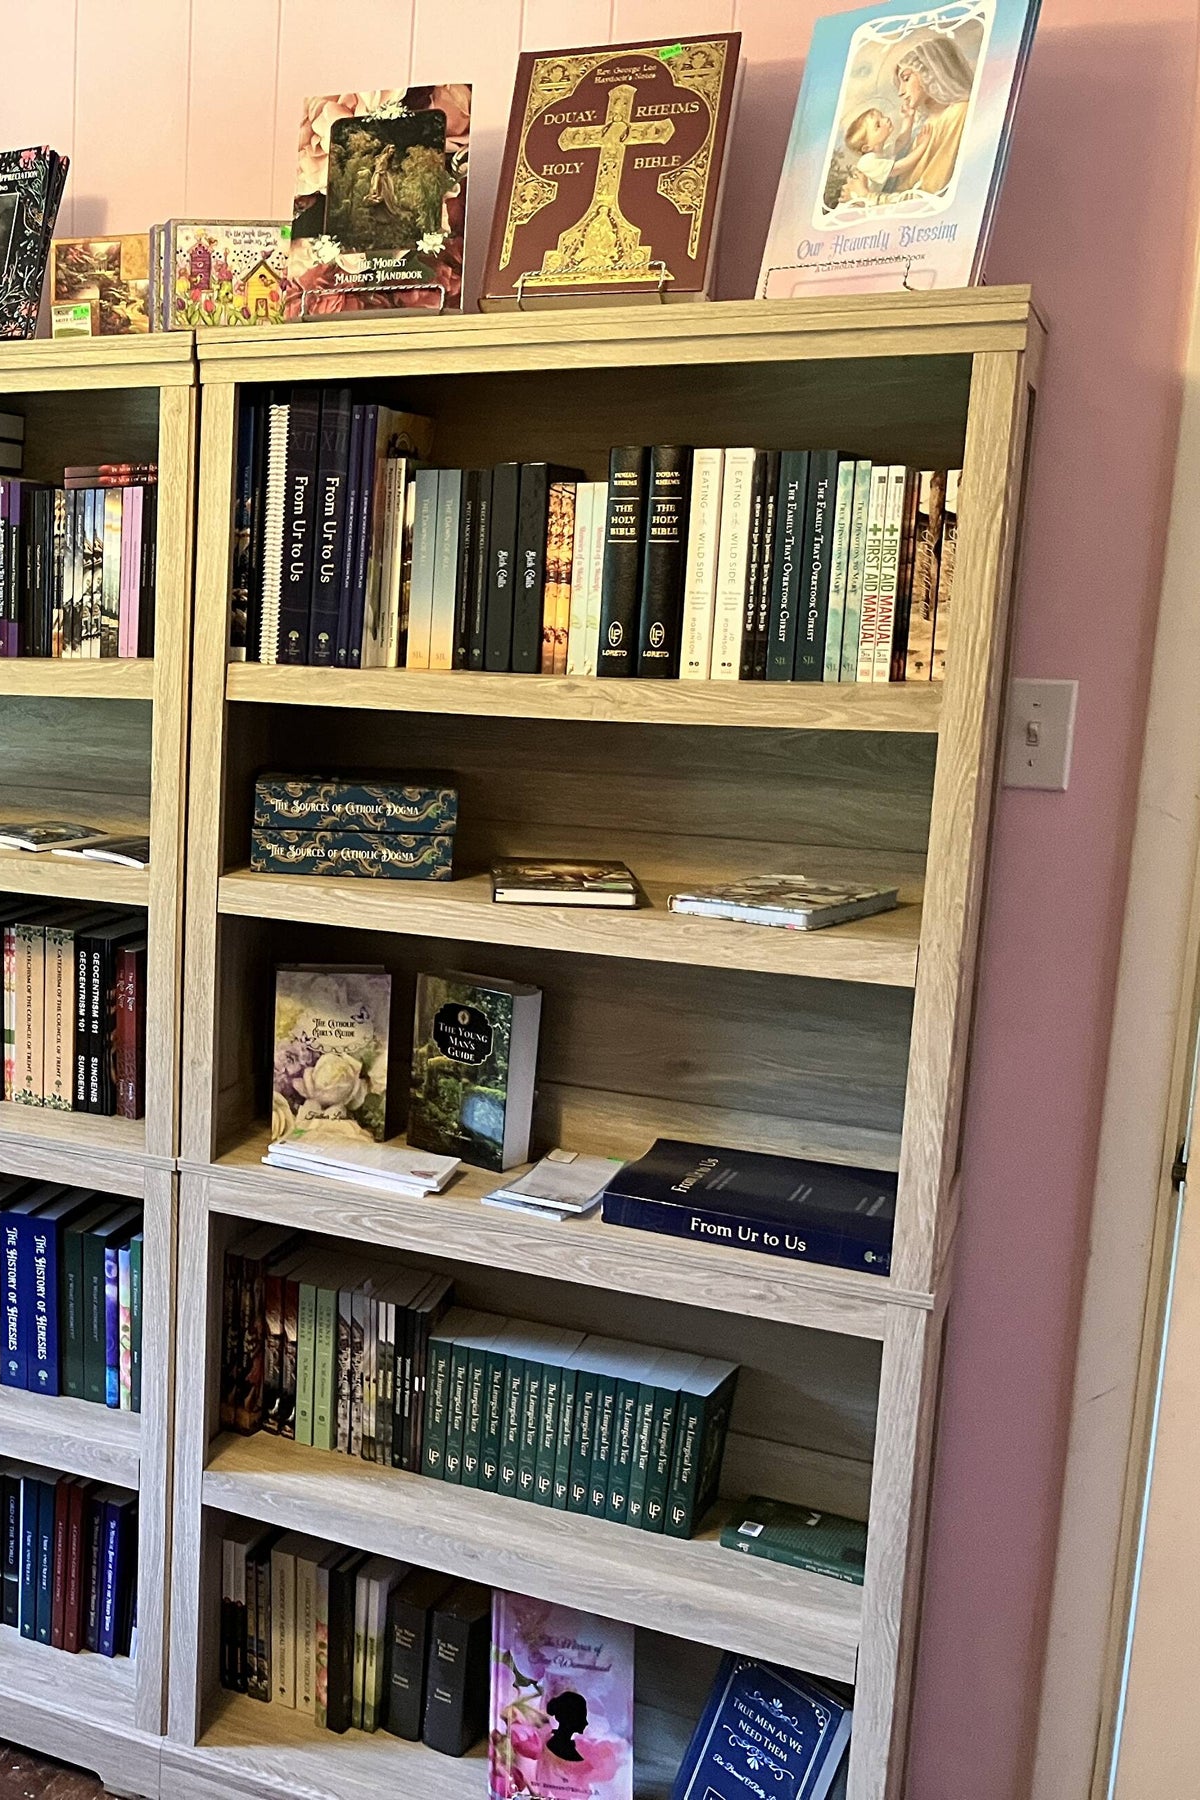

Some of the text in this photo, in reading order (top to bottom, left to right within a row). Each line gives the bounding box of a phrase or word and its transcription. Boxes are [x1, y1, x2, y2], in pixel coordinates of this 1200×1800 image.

[635, 102, 700, 118] RHEIMS
[541, 155, 682, 176] HOLY BIBLE
[796, 221, 959, 260] Our Heavenly Blessing
[373, 257, 407, 269] MODEST
[334, 271, 423, 285] MAIDEN'S HANDBOOK
[611, 516, 636, 524] HOLY
[614, 505, 633, 513] THE
[652, 516, 678, 524] HOLY
[656, 505, 676, 513] THE
[290, 476, 308, 582] From Ur to Us
[320, 477, 340, 583] From Ur to Us
[610, 527, 636, 536] BIBLE
[651, 528, 678, 536] BIBLE
[696, 470, 710, 584] EATING WILD SIDE
[728, 470, 743, 584] EATING WILD SIDE
[779, 481, 798, 642] THE FAMILY THAT OVERTOOK CHRIST
[806, 480, 828, 641] THE FAMILY THAT OVERTOOK CHRIST
[860, 539, 881, 646] FIRST AID MANUAL
[876, 539, 898, 646] FIRST AID MANUAL
[271, 799, 419, 816] THE SOURCES OF CATHOLIC DOGMA
[266, 844, 414, 862] THE SOURCES OF CATHOLIC DOGMA
[27, 985, 32, 994] OF
[91, 952, 100, 1034] GEOCENTRISM 101
[26, 1041, 32, 1049] OF
[439, 1022, 488, 1043] THE YOUNG
[449, 1035, 476, 1051] MAN'S
[447, 1046, 476, 1062] GUIDE
[690, 1217, 807, 1252] From Ur to Us
[6, 1227, 18, 1350] THE HISTORY OF HERESIES
[34, 1235, 47, 1360] THE HISTORY OF HERESIES
[435, 1360, 445, 1423] The Liturgical Year
[639, 1403, 653, 1470] The Liturgical Year
[733, 1696, 804, 1755] TRUE MEN AS WE
[738, 1719, 789, 1763] NEED THEM
